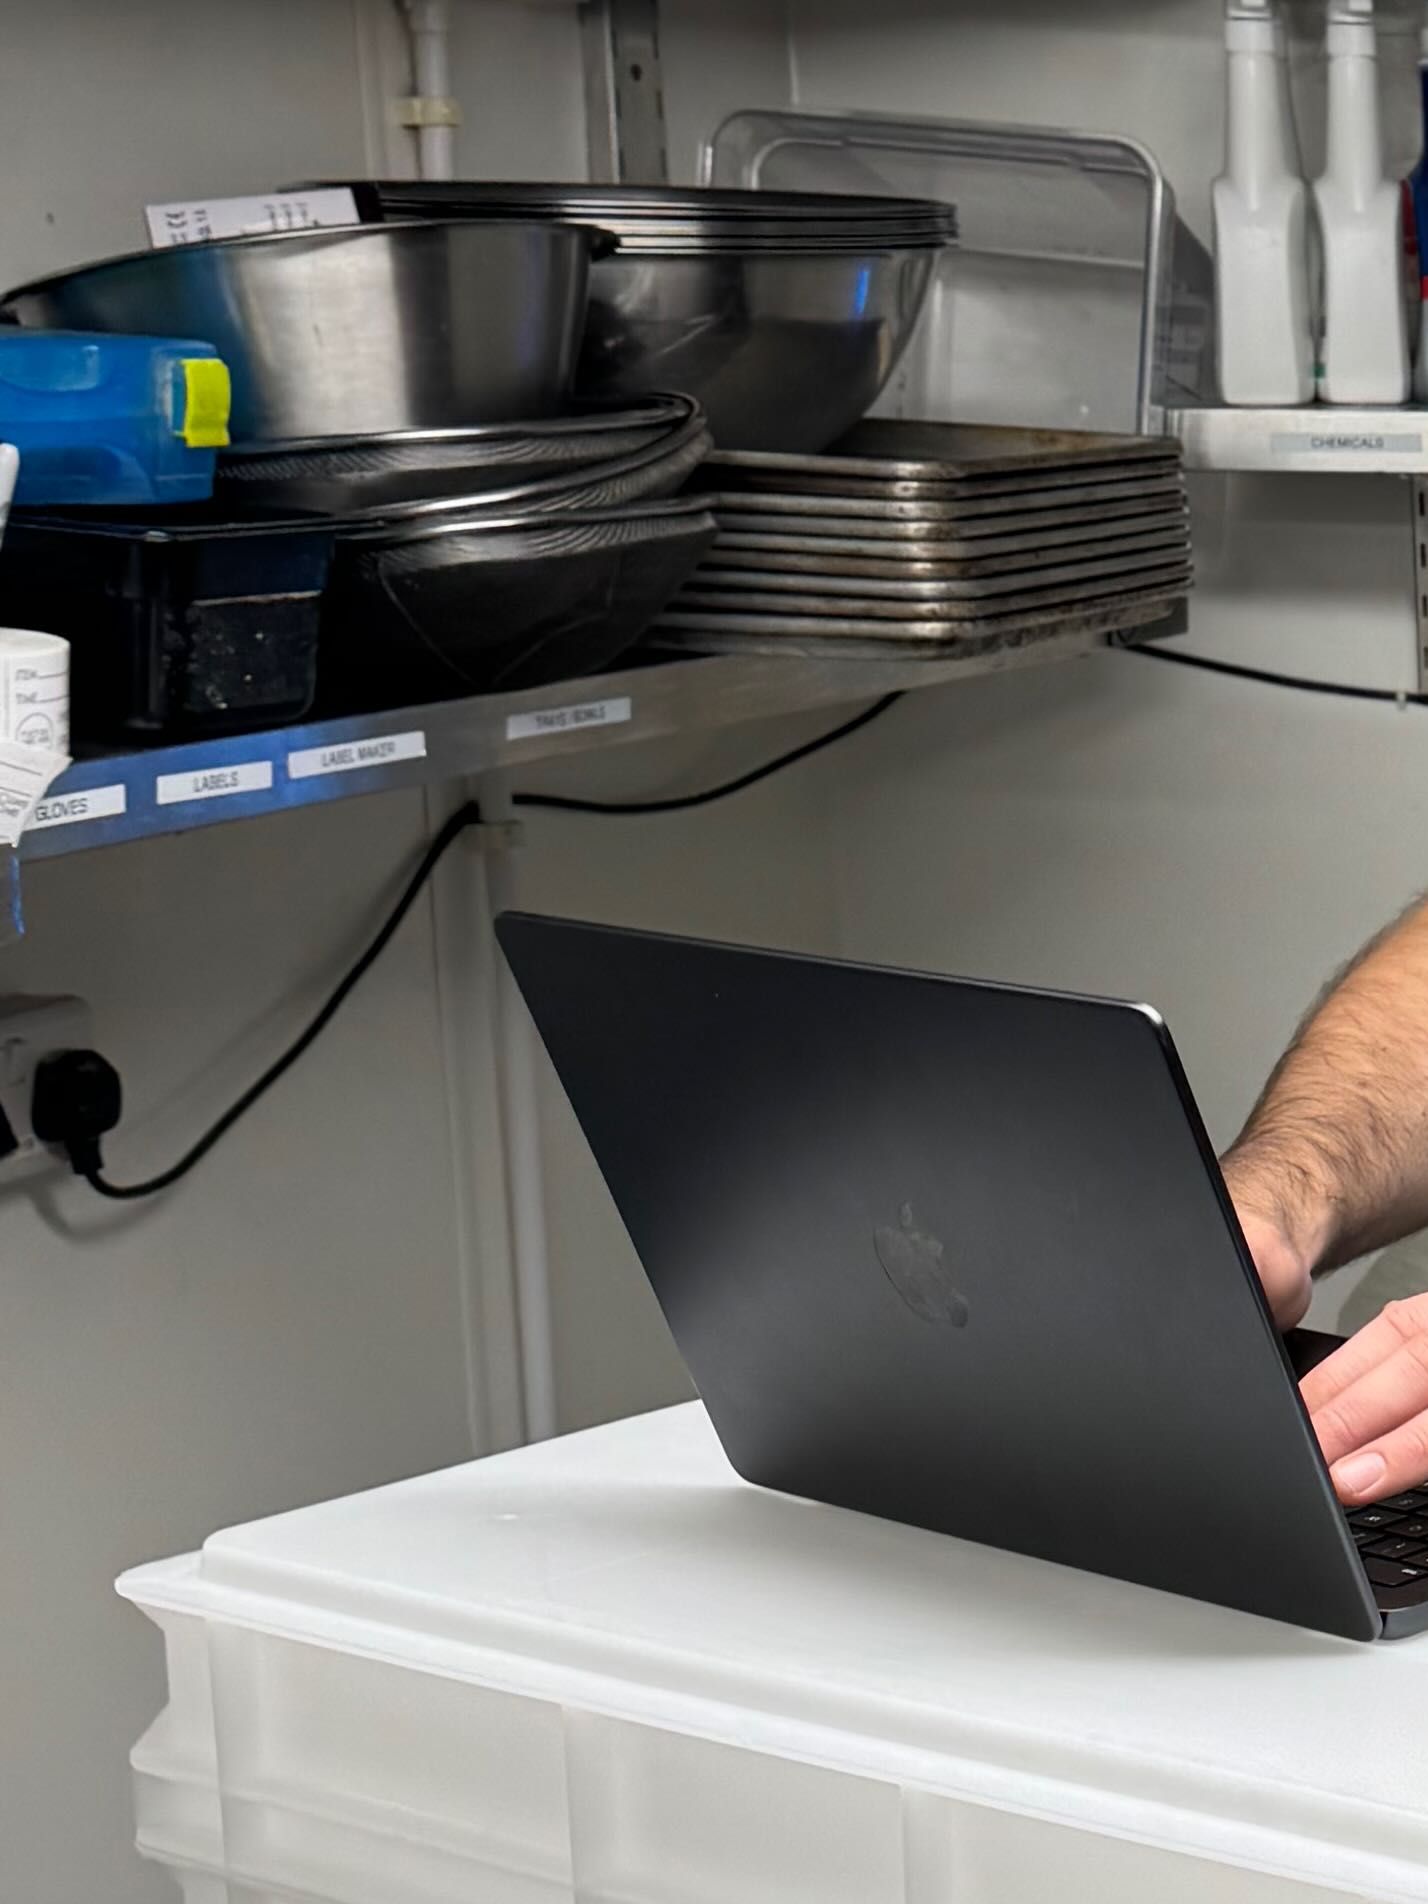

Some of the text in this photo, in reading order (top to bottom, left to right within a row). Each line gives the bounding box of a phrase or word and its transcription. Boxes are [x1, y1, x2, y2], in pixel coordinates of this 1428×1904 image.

[321, 748, 355, 768] LABEL
[193, 771, 240, 793] LABELS
[35, 797, 89, 822] GLOVES
